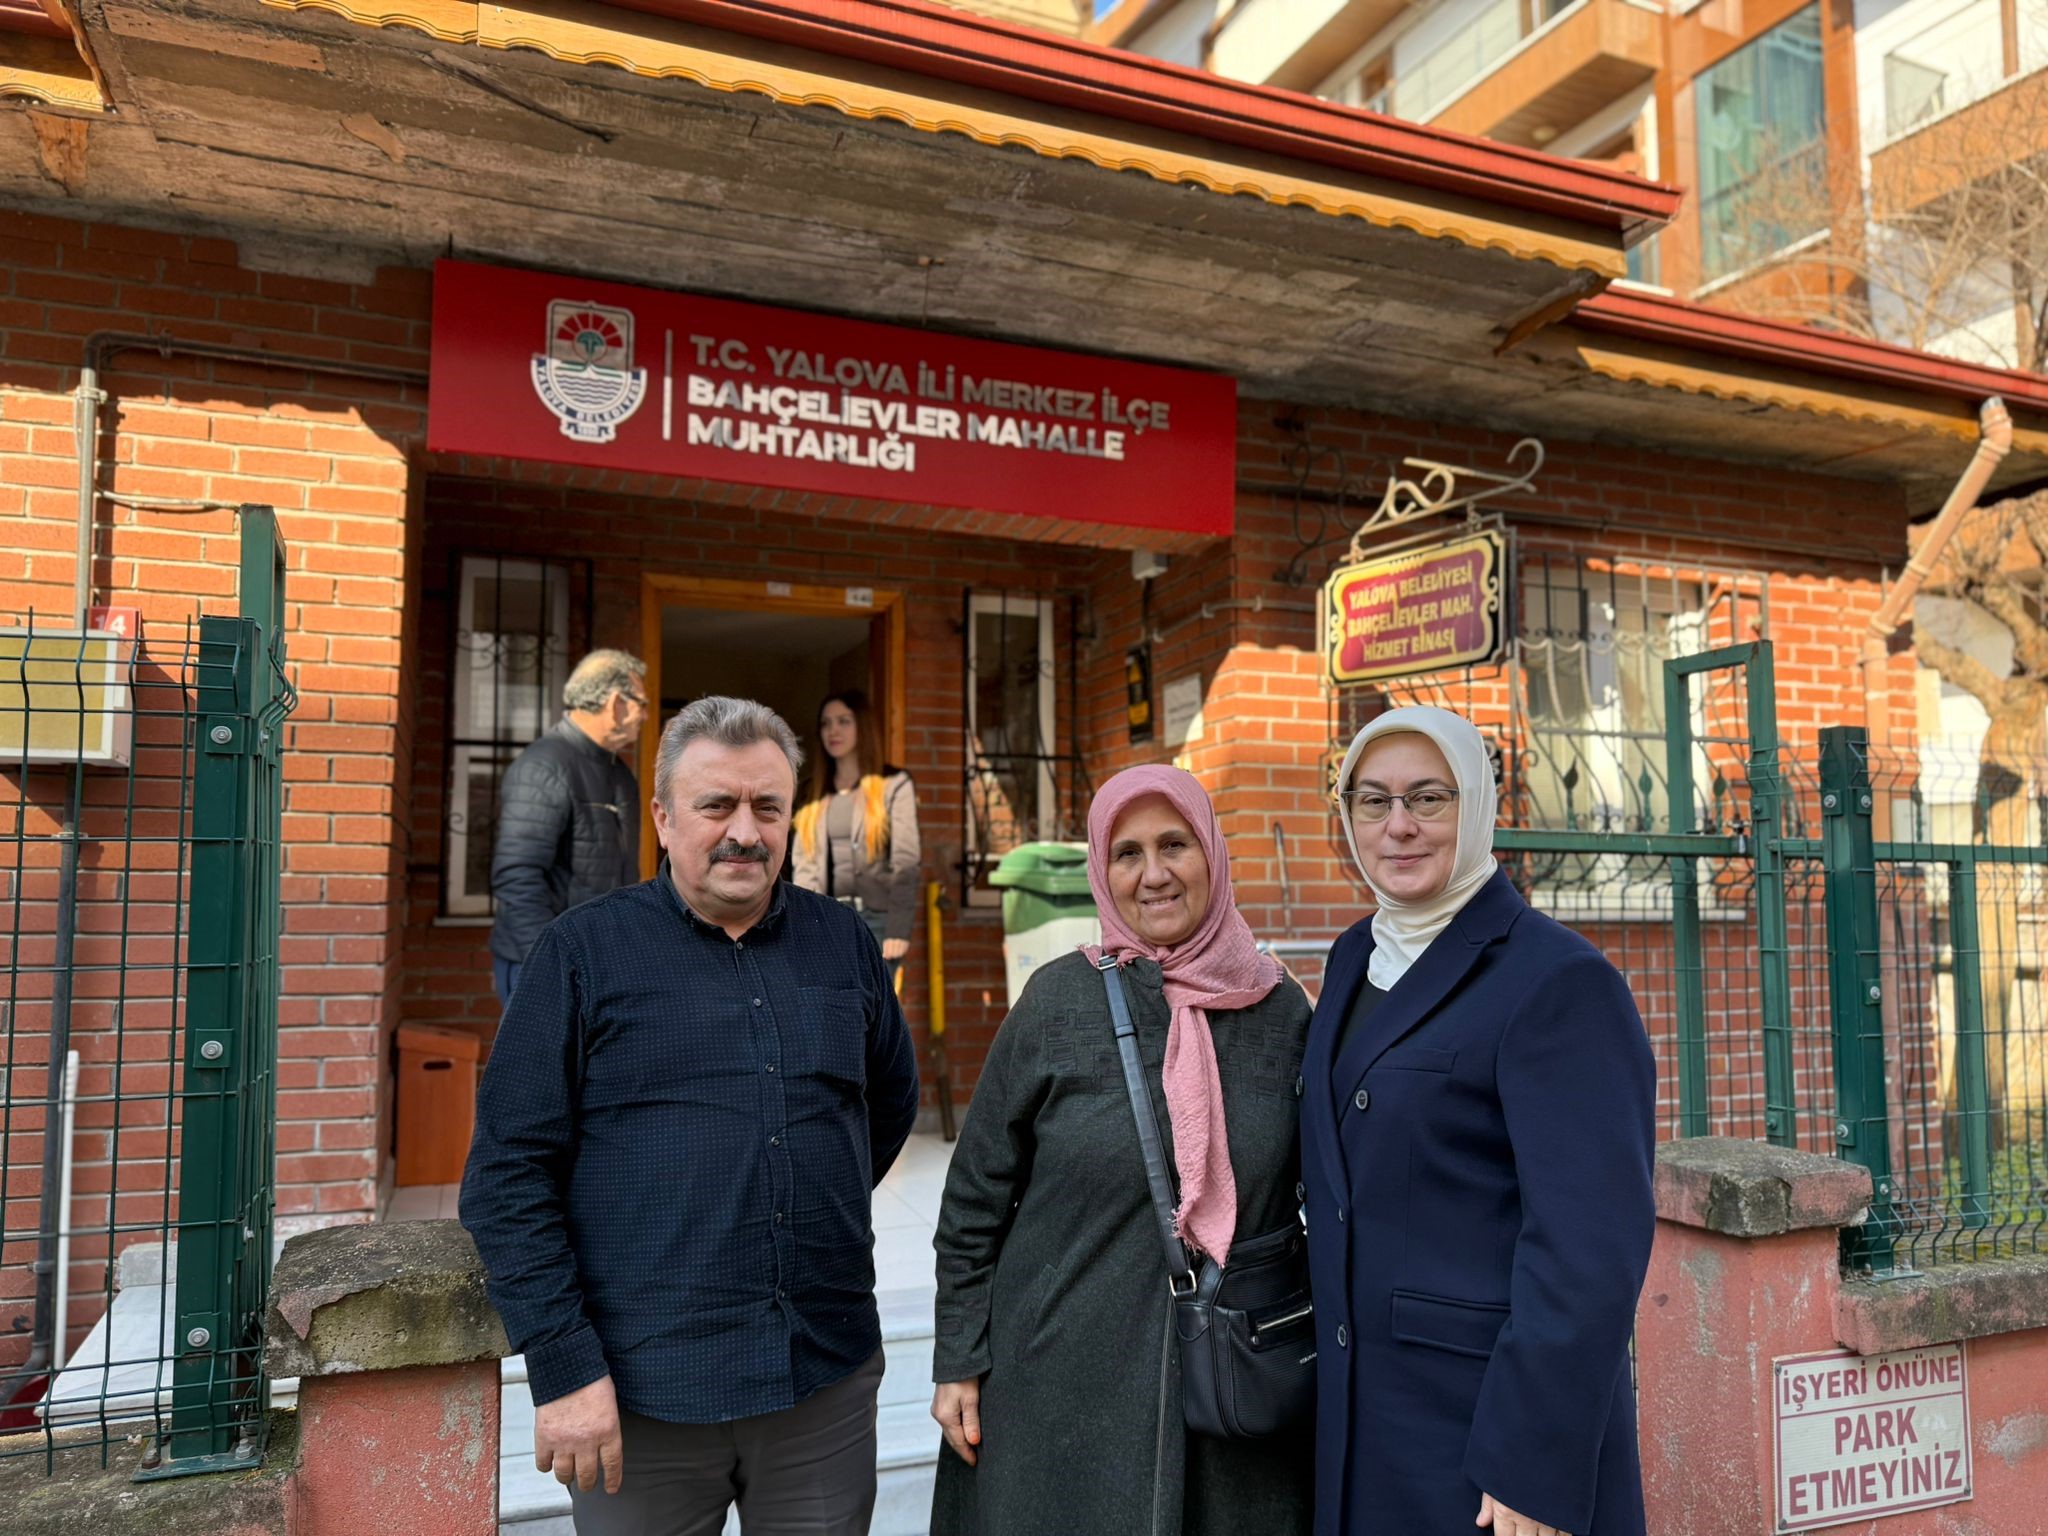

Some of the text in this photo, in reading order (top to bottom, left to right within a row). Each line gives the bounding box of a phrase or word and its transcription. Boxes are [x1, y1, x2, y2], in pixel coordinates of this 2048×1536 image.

[689, 334, 1170, 435] T.C. YALOVA İLİ MERKEZ İLÇE
[687, 412, 915, 472] MUHTARLIĞI
[688, 374, 1125, 461] BAHÇELİEVLER MAHALLE
[1349, 560, 1474, 611] YALOVA BELEDİYESİ
[1347, 595, 1475, 639] BAHÇELİEVLER MAH.
[1363, 636, 1410, 663] HİZMET
[1783, 1353, 1960, 1412] İŞYERİ ÖNÜNE
[1834, 1406, 1918, 1456] PARK
[1788, 1442, 1963, 1517] ETMEYİNİZ
